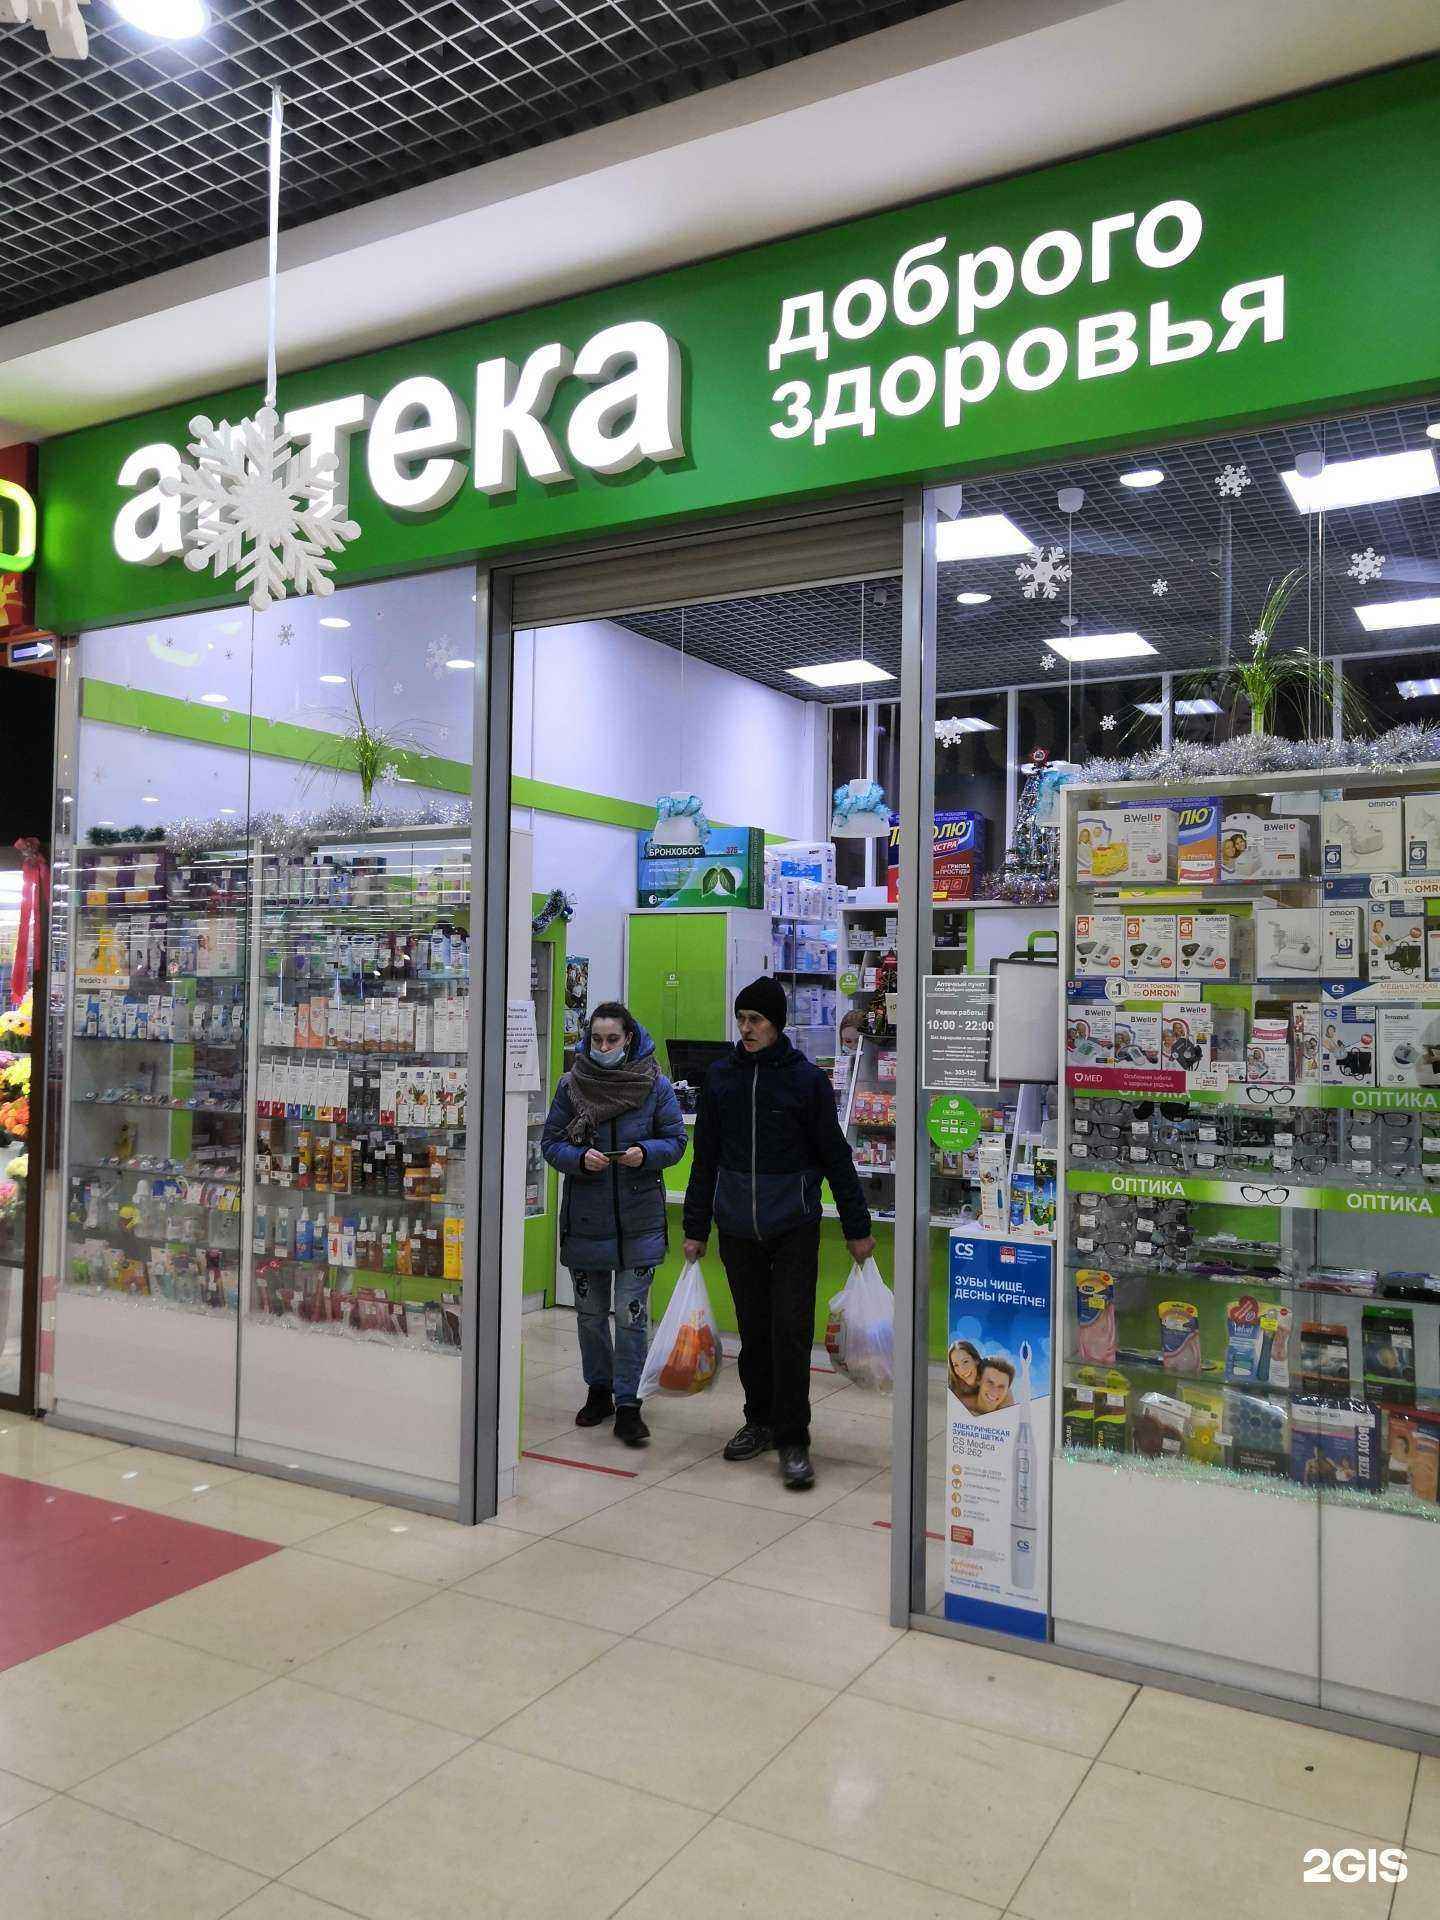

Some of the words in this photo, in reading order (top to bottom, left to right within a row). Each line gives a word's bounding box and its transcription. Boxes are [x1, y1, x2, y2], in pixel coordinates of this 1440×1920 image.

[768, 199, 1202, 370] доброго
[769, 274, 1285, 446] здоровья
[648, 846, 701, 857] БРОНХОБОС
[927, 1020, 956, 1030] 10:00
[965, 1020, 994, 1031] 22:00
[1352, 1090, 1439, 1108] ОПТИКА
[1111, 1176, 1185, 1196] ОПТИКА
[1346, 1193, 1433, 1215] ОПТИКА
[954, 1242, 974, 1256] CS
[954, 1275, 987, 1288] ЗУБЫ
[989, 1279, 1026, 1294] ЧИЩЕ,
[954, 1288, 995, 1301] ДЕСНЫ
[997, 1293, 1046, 1308] КРЕПЧЕ!
[952, 1436, 965, 1446] CS
[1016, 1540, 1030, 1550] CS
